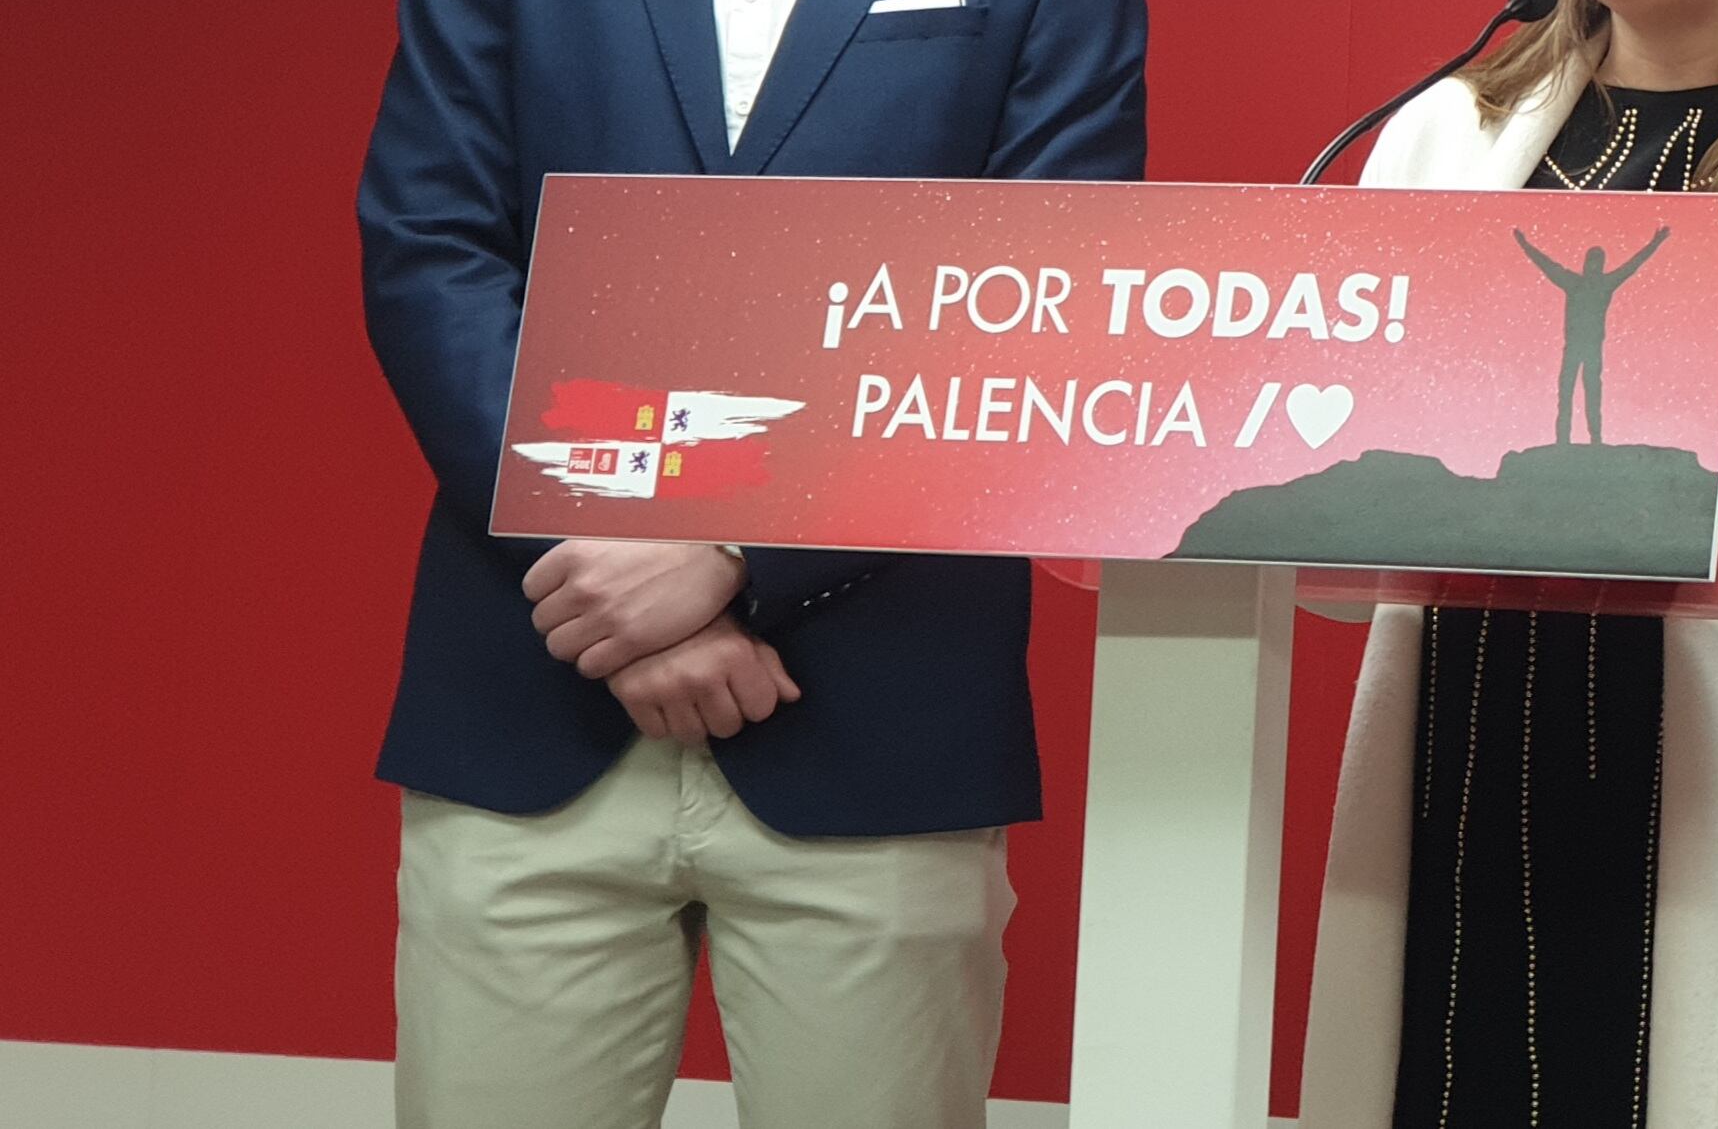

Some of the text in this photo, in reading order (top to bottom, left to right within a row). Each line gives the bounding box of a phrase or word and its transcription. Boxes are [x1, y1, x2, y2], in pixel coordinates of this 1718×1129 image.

[929, 265, 1072, 335] POR
[1102, 268, 1410, 343] TODAS!
[852, 373, 1208, 447] PALENCIA
